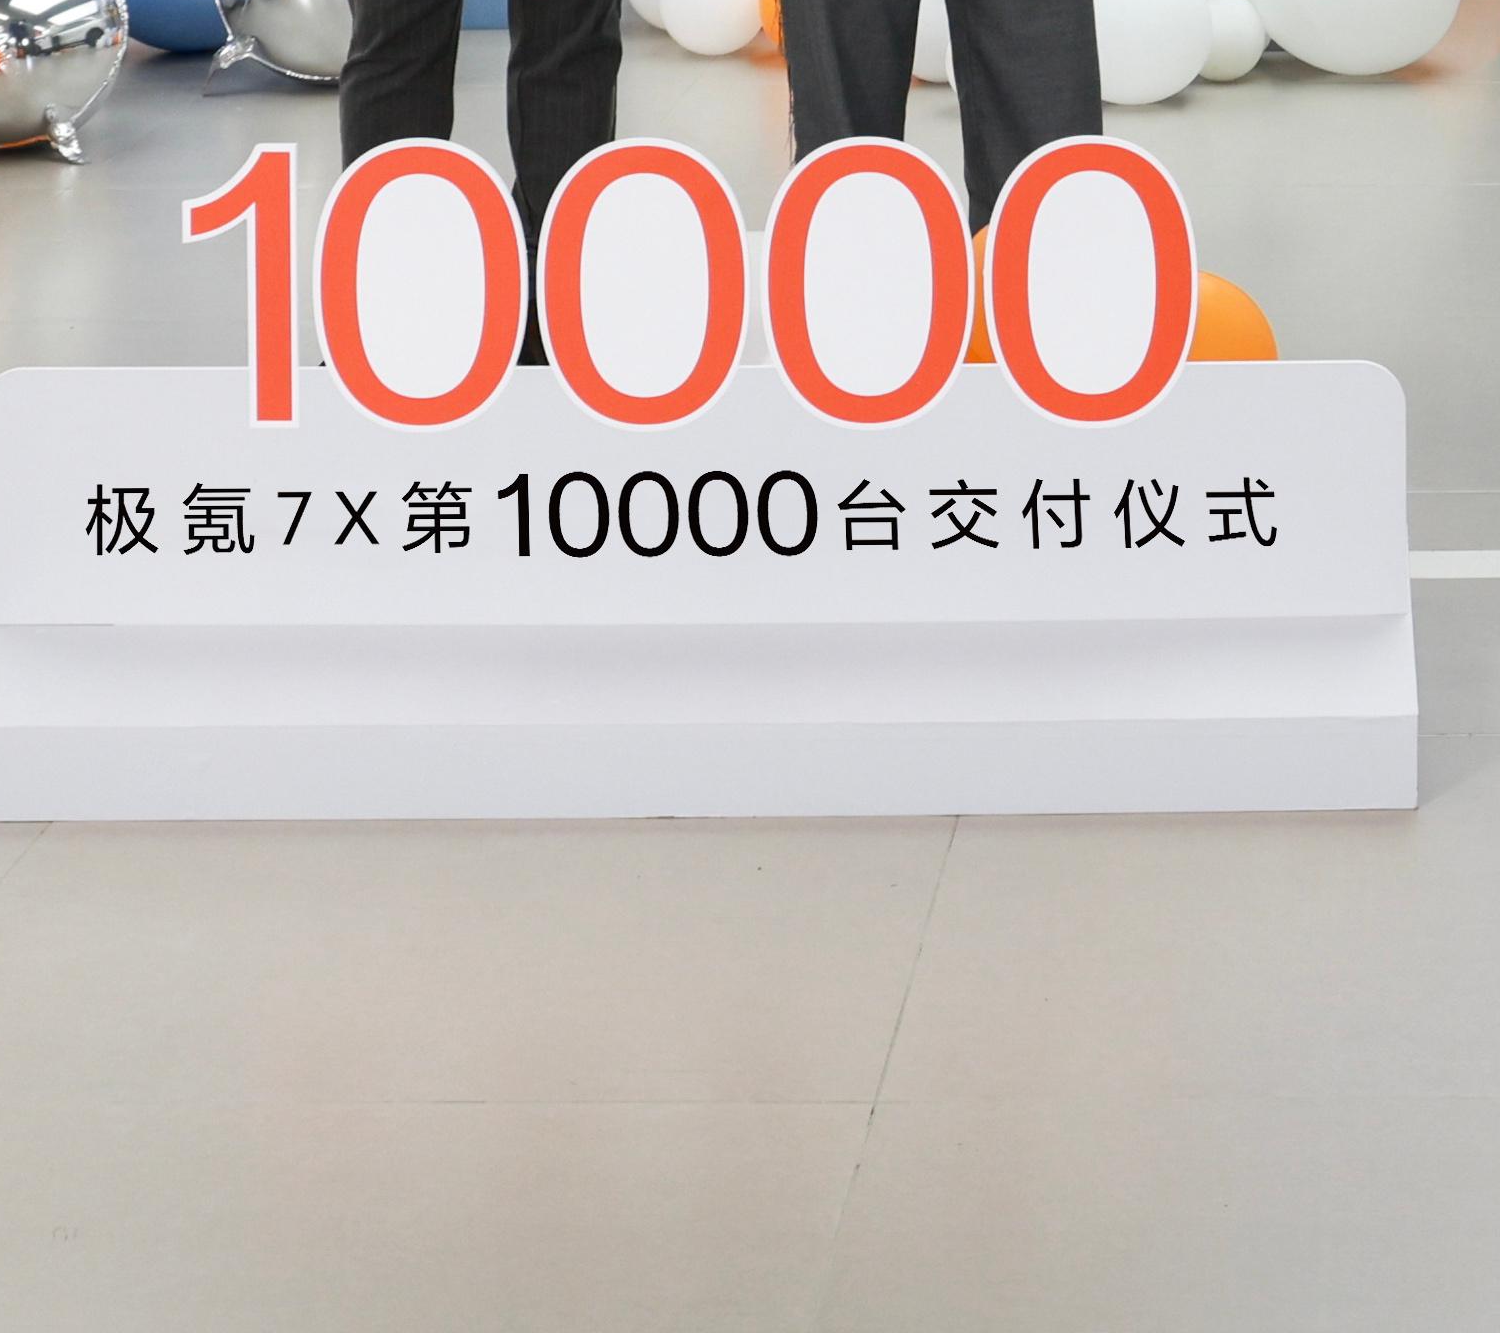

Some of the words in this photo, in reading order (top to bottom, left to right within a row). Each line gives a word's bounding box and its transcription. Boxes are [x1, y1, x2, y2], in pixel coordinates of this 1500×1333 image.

[186, 140, 1196, 427] 10000
[83, 467, 1280, 560] 极氪7X第10000台交付仪式
